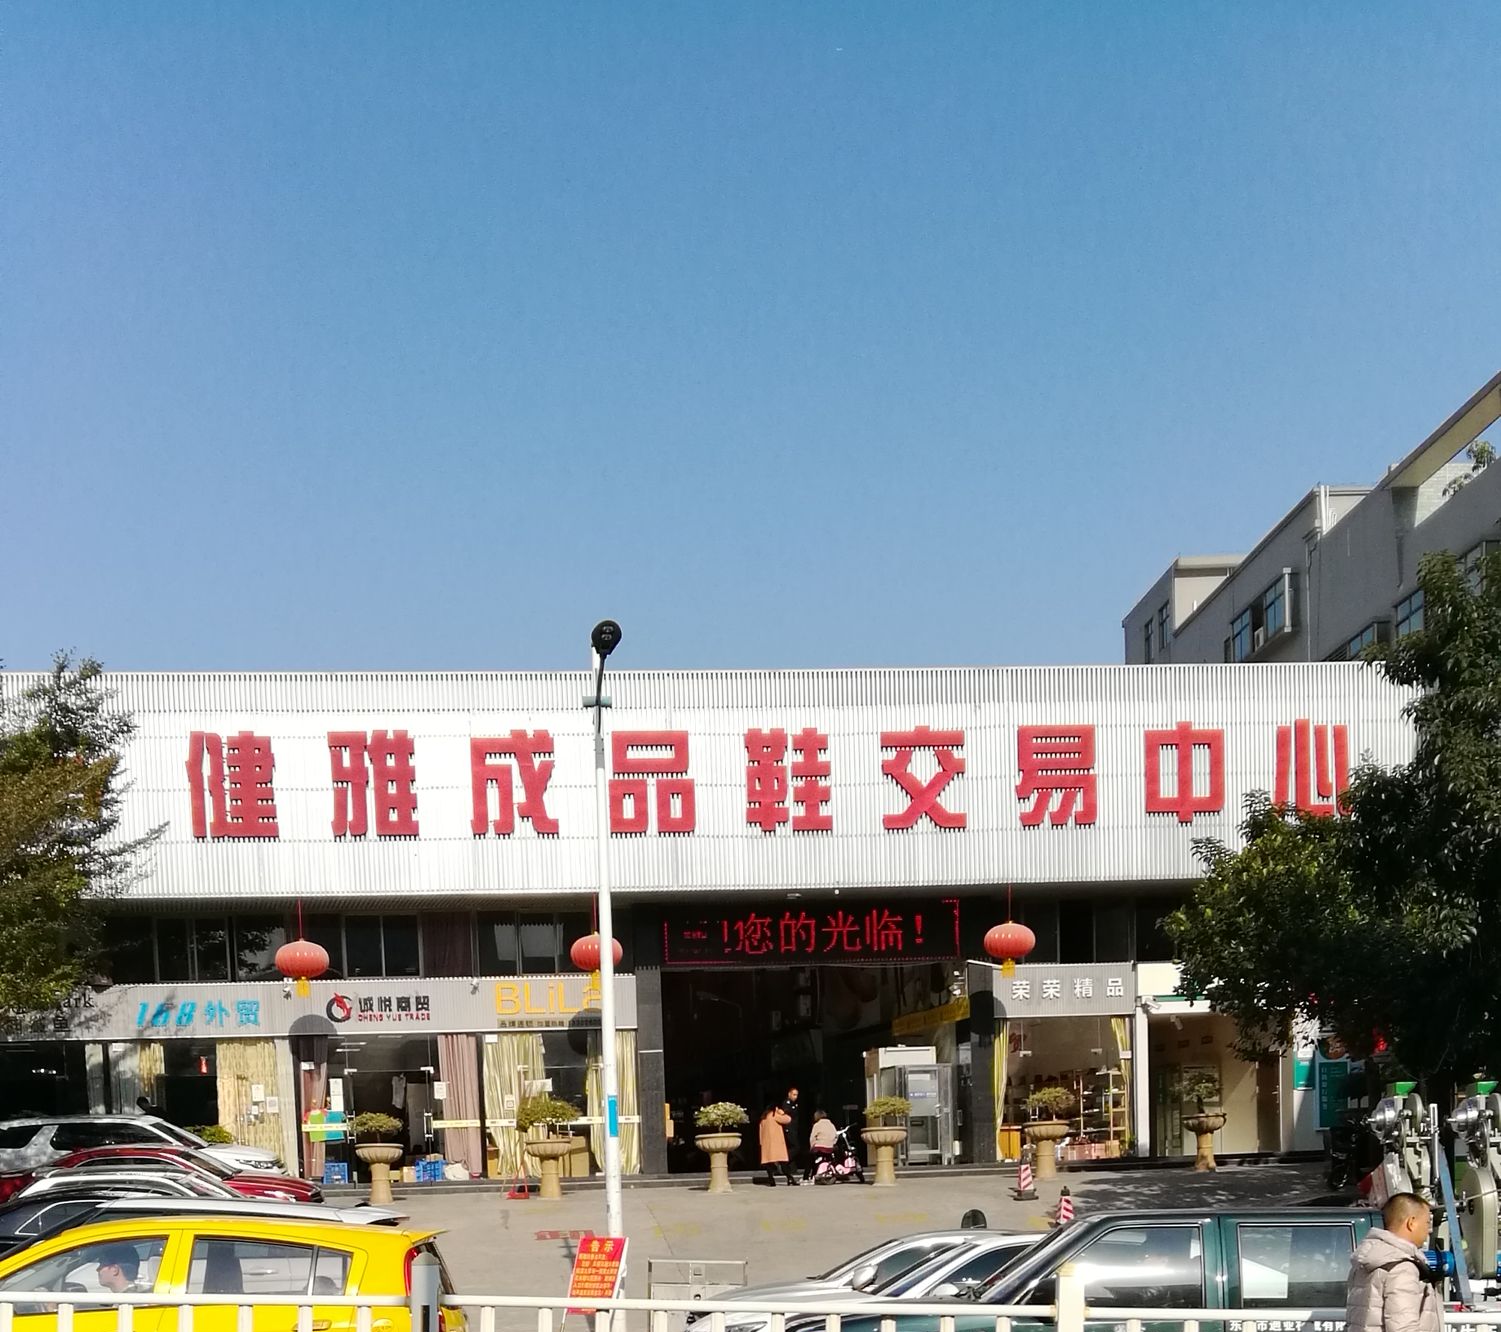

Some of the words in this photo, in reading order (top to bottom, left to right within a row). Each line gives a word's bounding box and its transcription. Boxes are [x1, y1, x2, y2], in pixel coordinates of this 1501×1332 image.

[186, 718, 1354, 838] 健雅成品鞋交易中心
[1011, 977, 1125, 1000] 荣荣精品
[358, 996, 430, 1012] 诚悦商贸
[405, 1013, 431, 1021] TRADE
[590, 1239, 614, 1252] 告示
